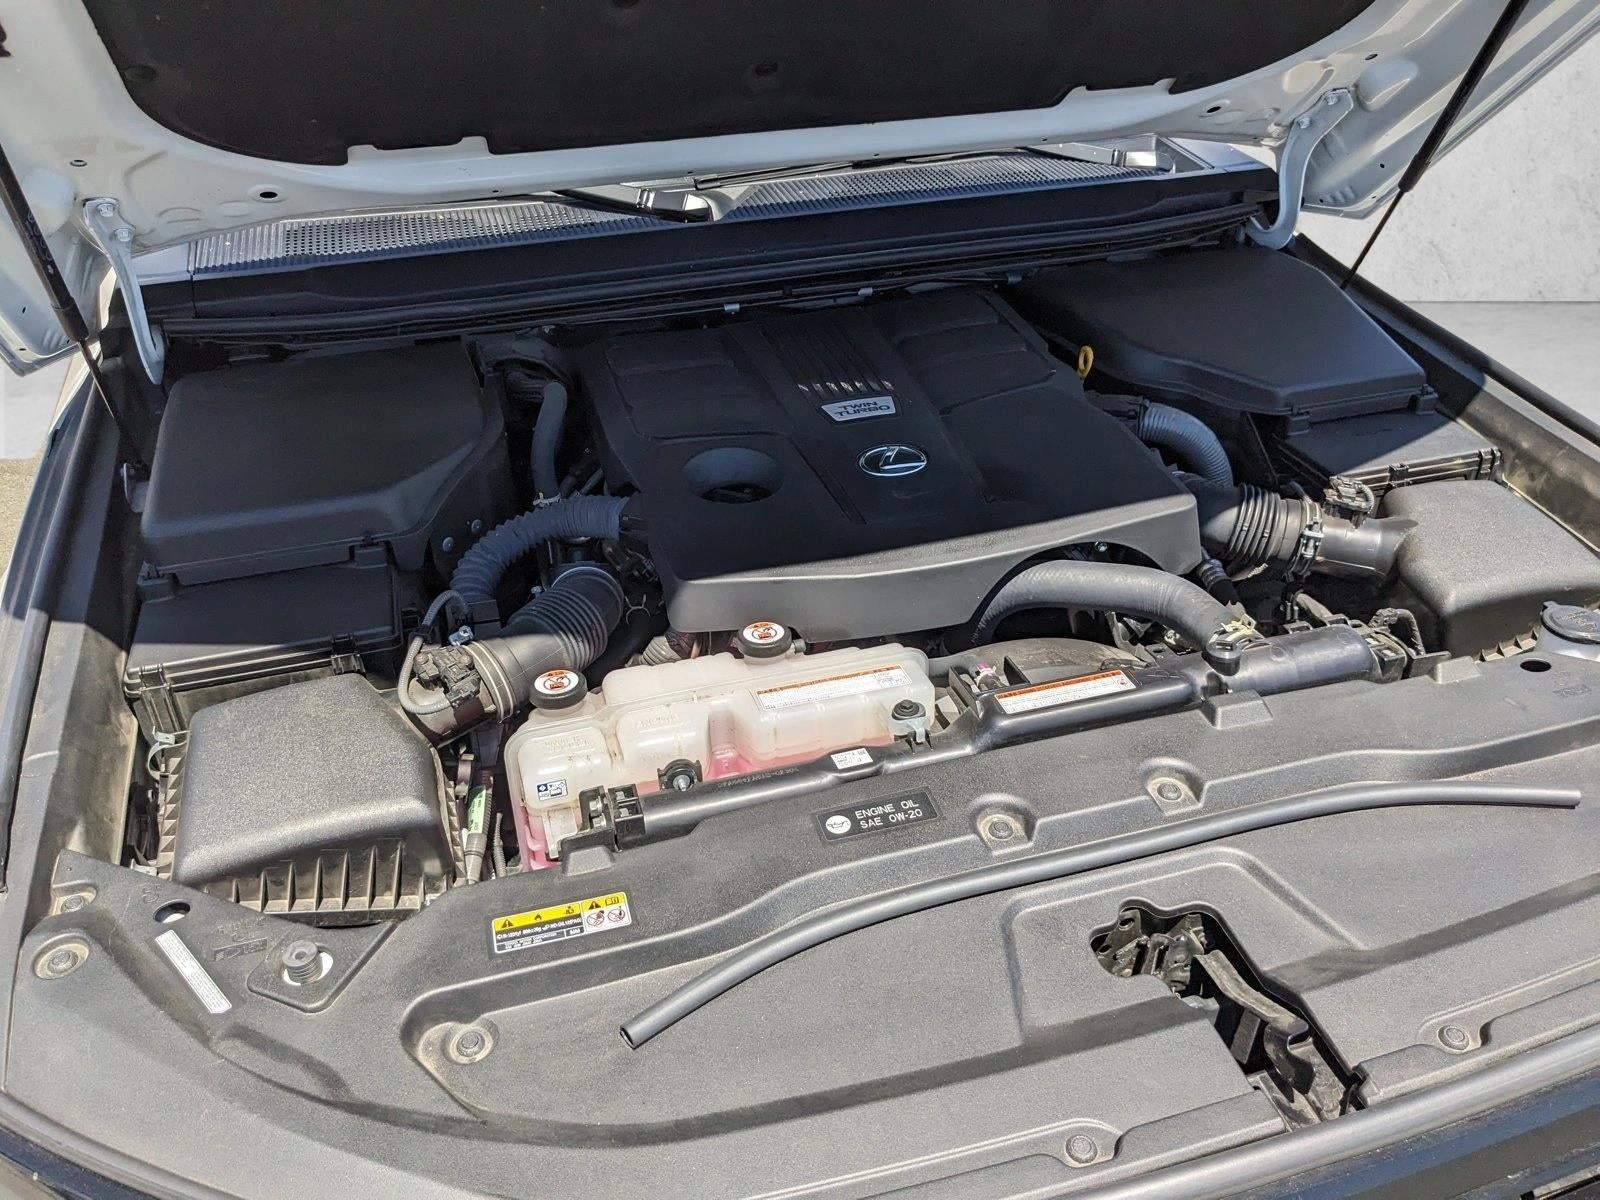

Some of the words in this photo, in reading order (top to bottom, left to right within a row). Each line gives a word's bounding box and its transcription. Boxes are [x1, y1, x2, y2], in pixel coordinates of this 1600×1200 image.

[834, 404, 891, 417] TURBO
[838, 401, 878, 411] TWIN
[855, 803, 896, 819] ENGINE
[900, 799, 919, 809] OIL
[860, 817, 884, 829] SAE
[888, 808, 923, 823] 0W-20
